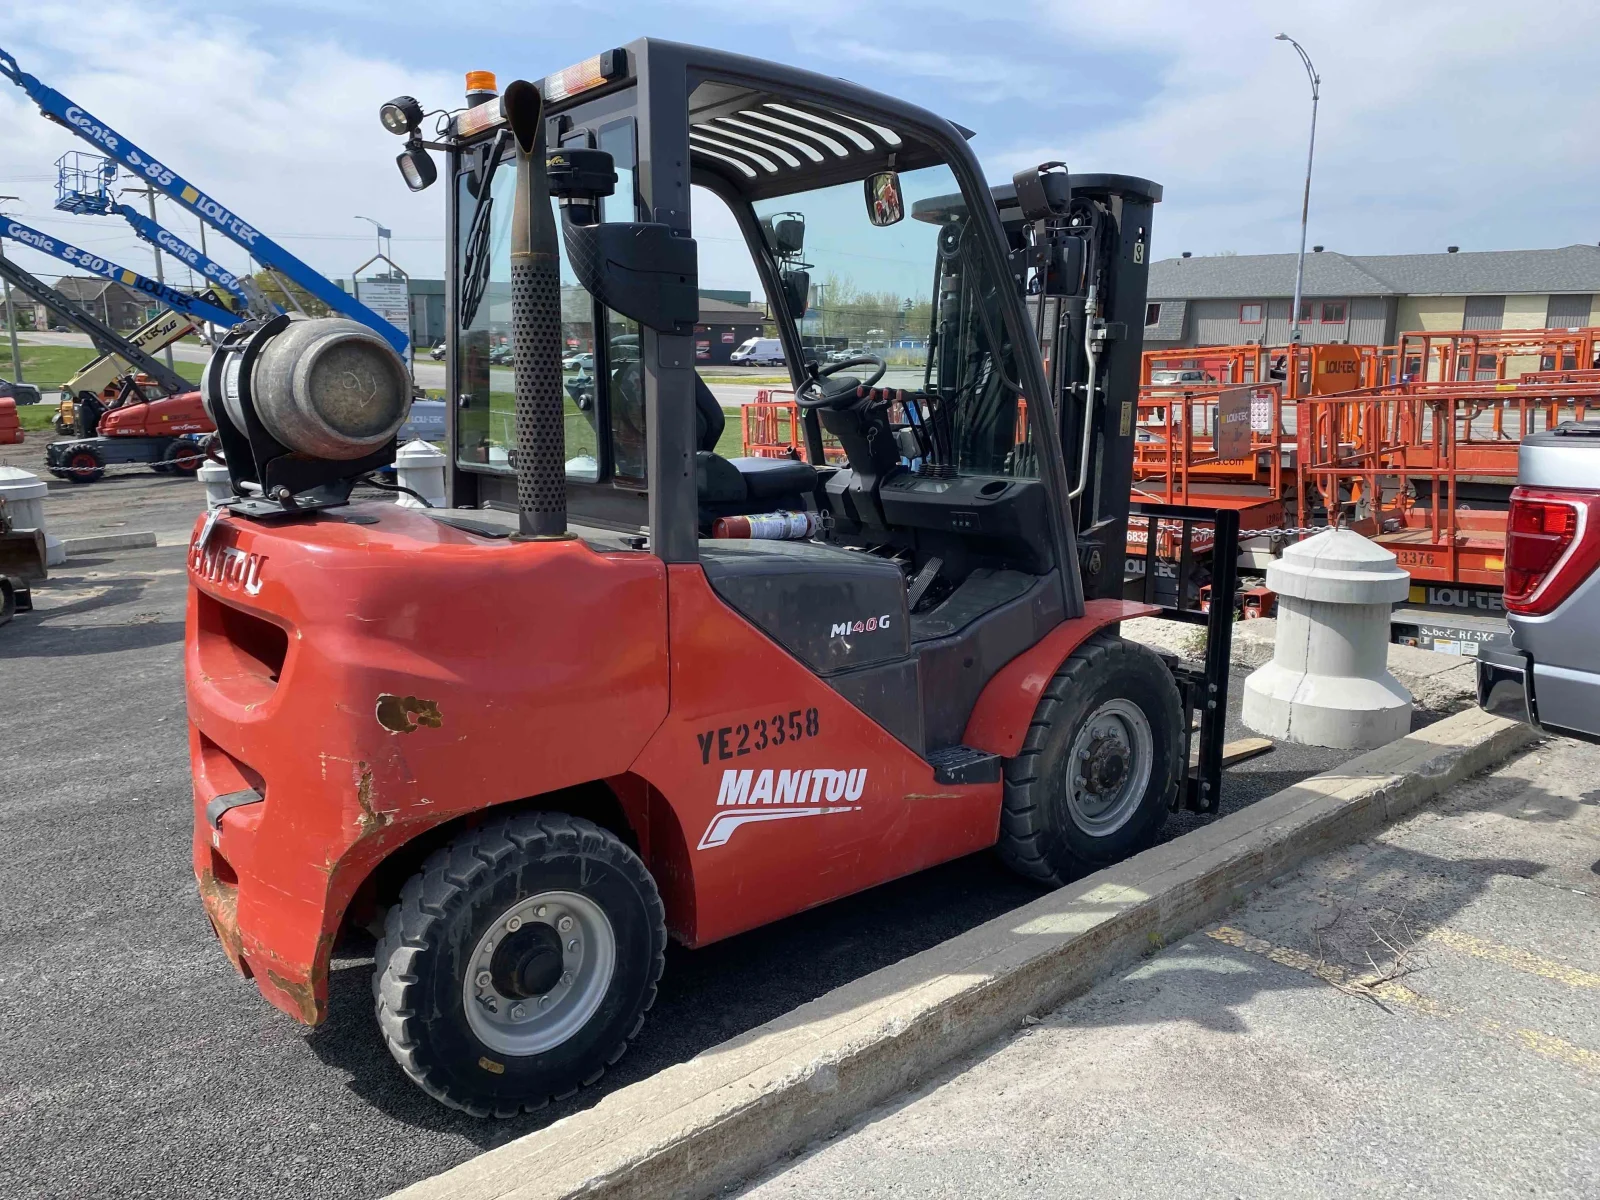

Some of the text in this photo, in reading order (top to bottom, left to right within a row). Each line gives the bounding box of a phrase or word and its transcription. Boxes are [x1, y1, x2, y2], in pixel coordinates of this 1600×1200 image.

[65, 106, 261, 245] Genie S-85 LOU-TEC
[157, 230, 199, 263] Genie
[7, 223, 54, 250] Genie
[136, 275, 195, 309] LOU-TEC
[134, 320, 177, 347] U-TEC JLG
[1326, 360, 1356, 373] LOU-TEC
[411, 415, 443, 424] LOU-TEC
[1226, 411, 1249, 424] LOU-TEC
[1429, 587, 1503, 611] LOU-TE
[830, 614, 891, 638] MI40G
[696, 707, 820, 765] YE23358
[716, 768, 868, 806] MANITOU
